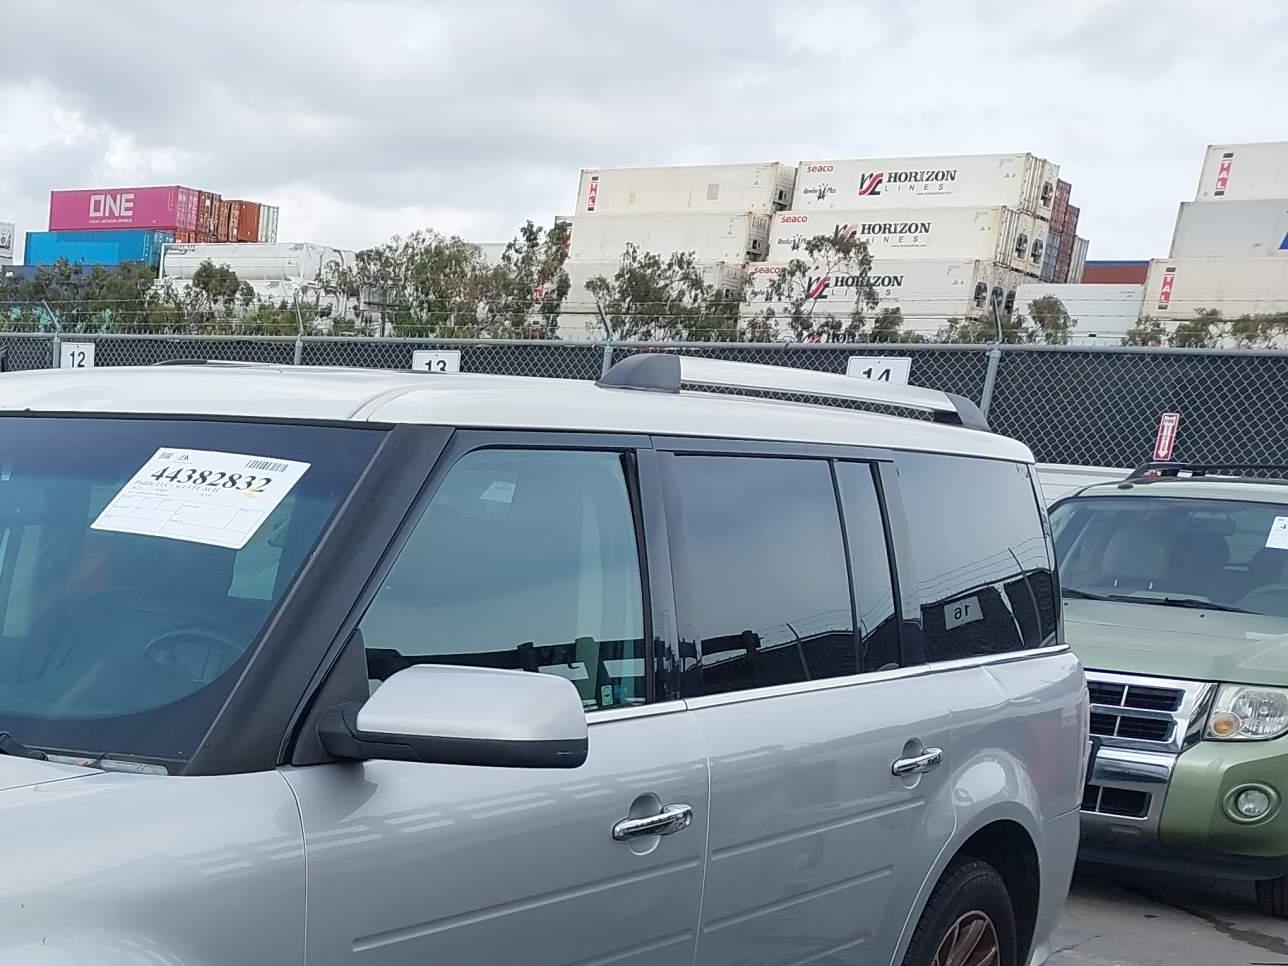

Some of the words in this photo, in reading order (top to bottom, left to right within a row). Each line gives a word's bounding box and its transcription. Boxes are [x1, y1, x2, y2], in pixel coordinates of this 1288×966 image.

[807, 165, 834, 173] seaco
[887, 170, 958, 183] HORIZON
[884, 184, 944, 192] LINES
[89, 193, 135, 217] ONE
[781, 215, 808, 224] seaco
[860, 222, 932, 235] HORIZON
[857, 235, 919, 244] INES
[834, 275, 905, 288] HOZON
[831, 288, 891, 297] LIS
[69, 351, 86, 368] 12
[150, 465, 273, 493] 44382832
